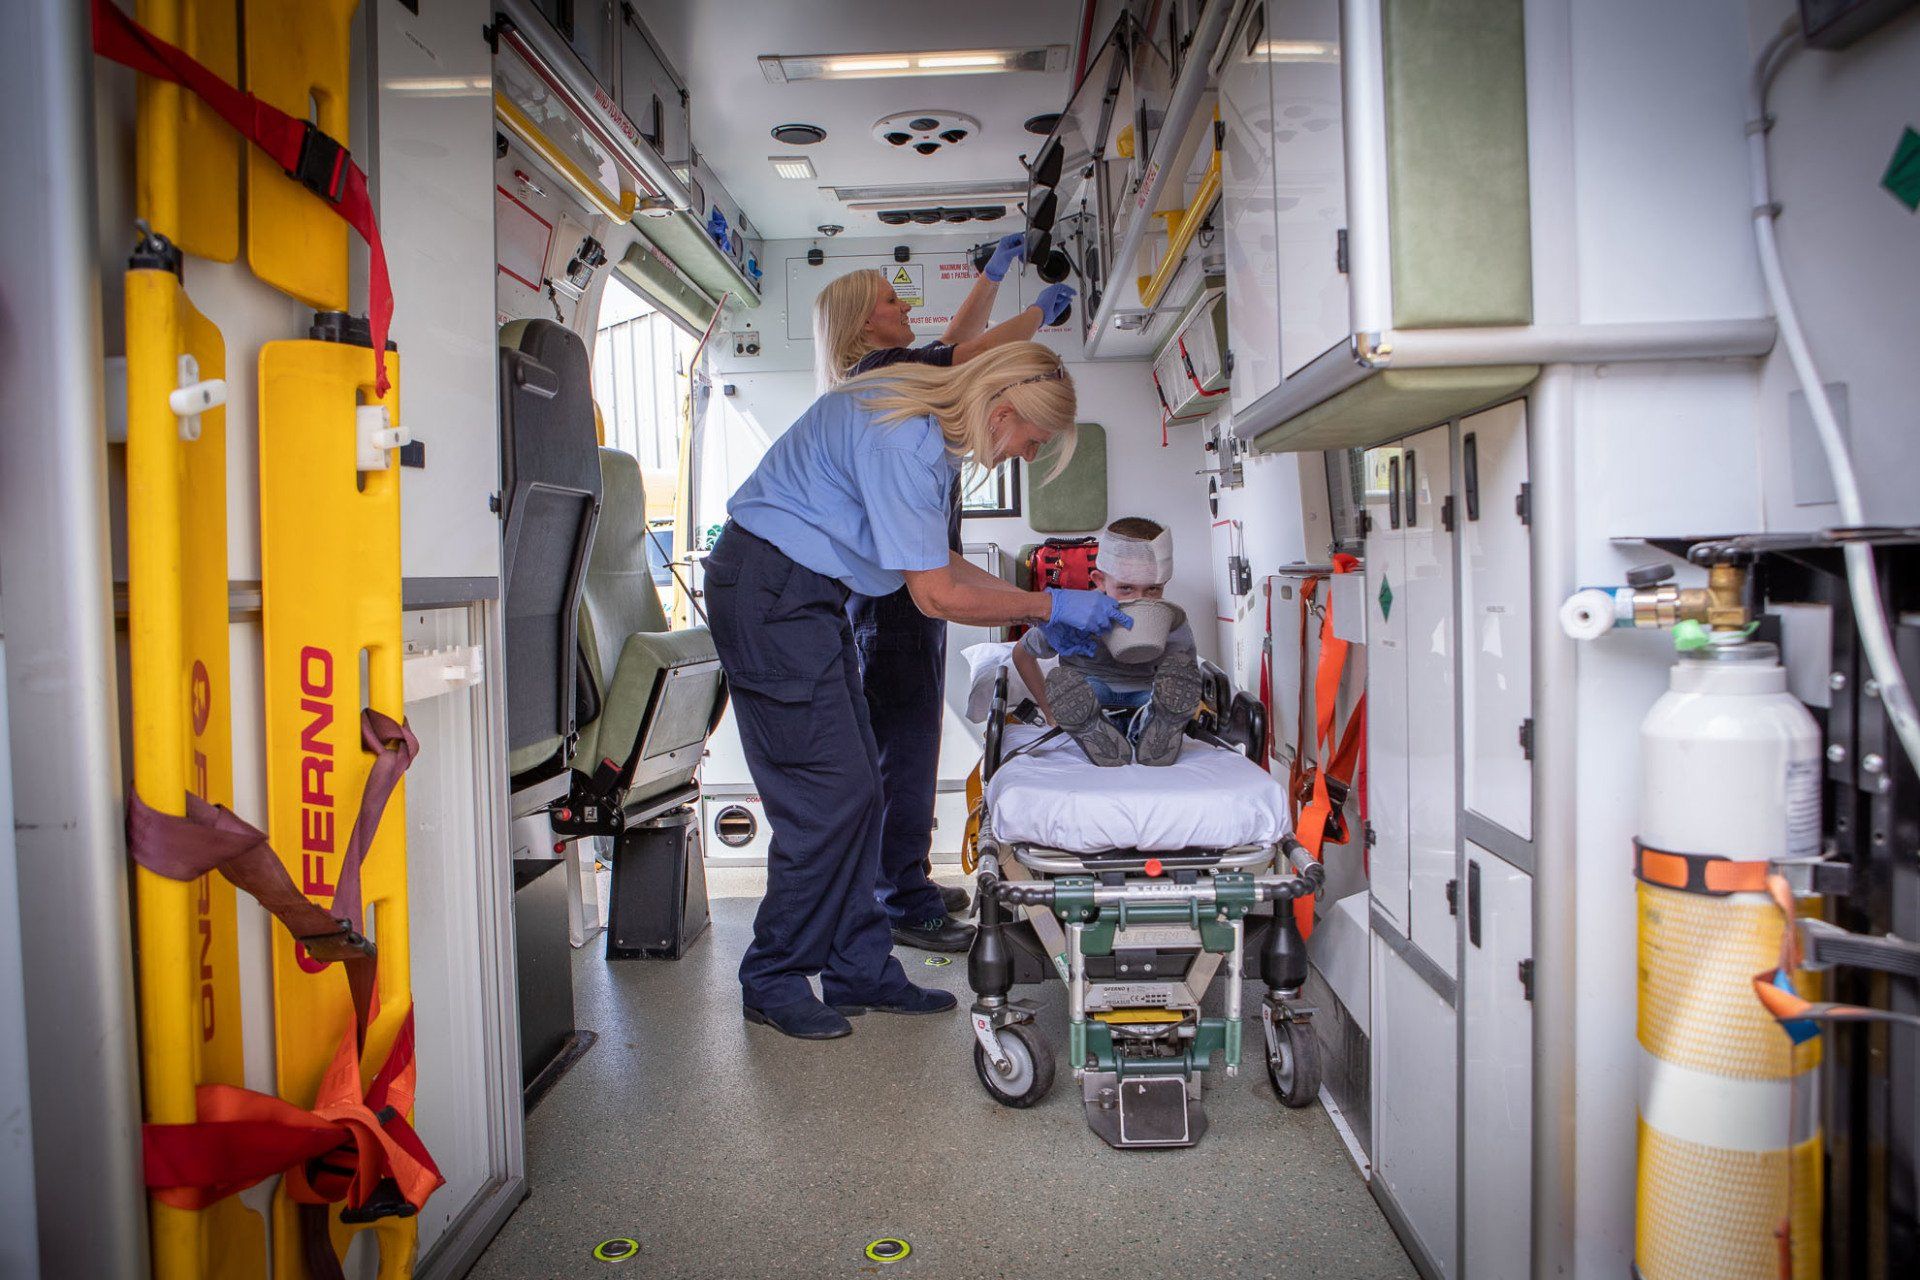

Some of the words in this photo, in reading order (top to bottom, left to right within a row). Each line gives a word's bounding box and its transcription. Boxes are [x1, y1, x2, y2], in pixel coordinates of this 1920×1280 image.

[939, 263, 961, 271] MAXIMUM
[933, 315, 948, 323] WORN
[301, 645, 335, 896] FERNO
[1142, 885, 1192, 895] FERNO
[194, 750, 214, 1043] FRNO
